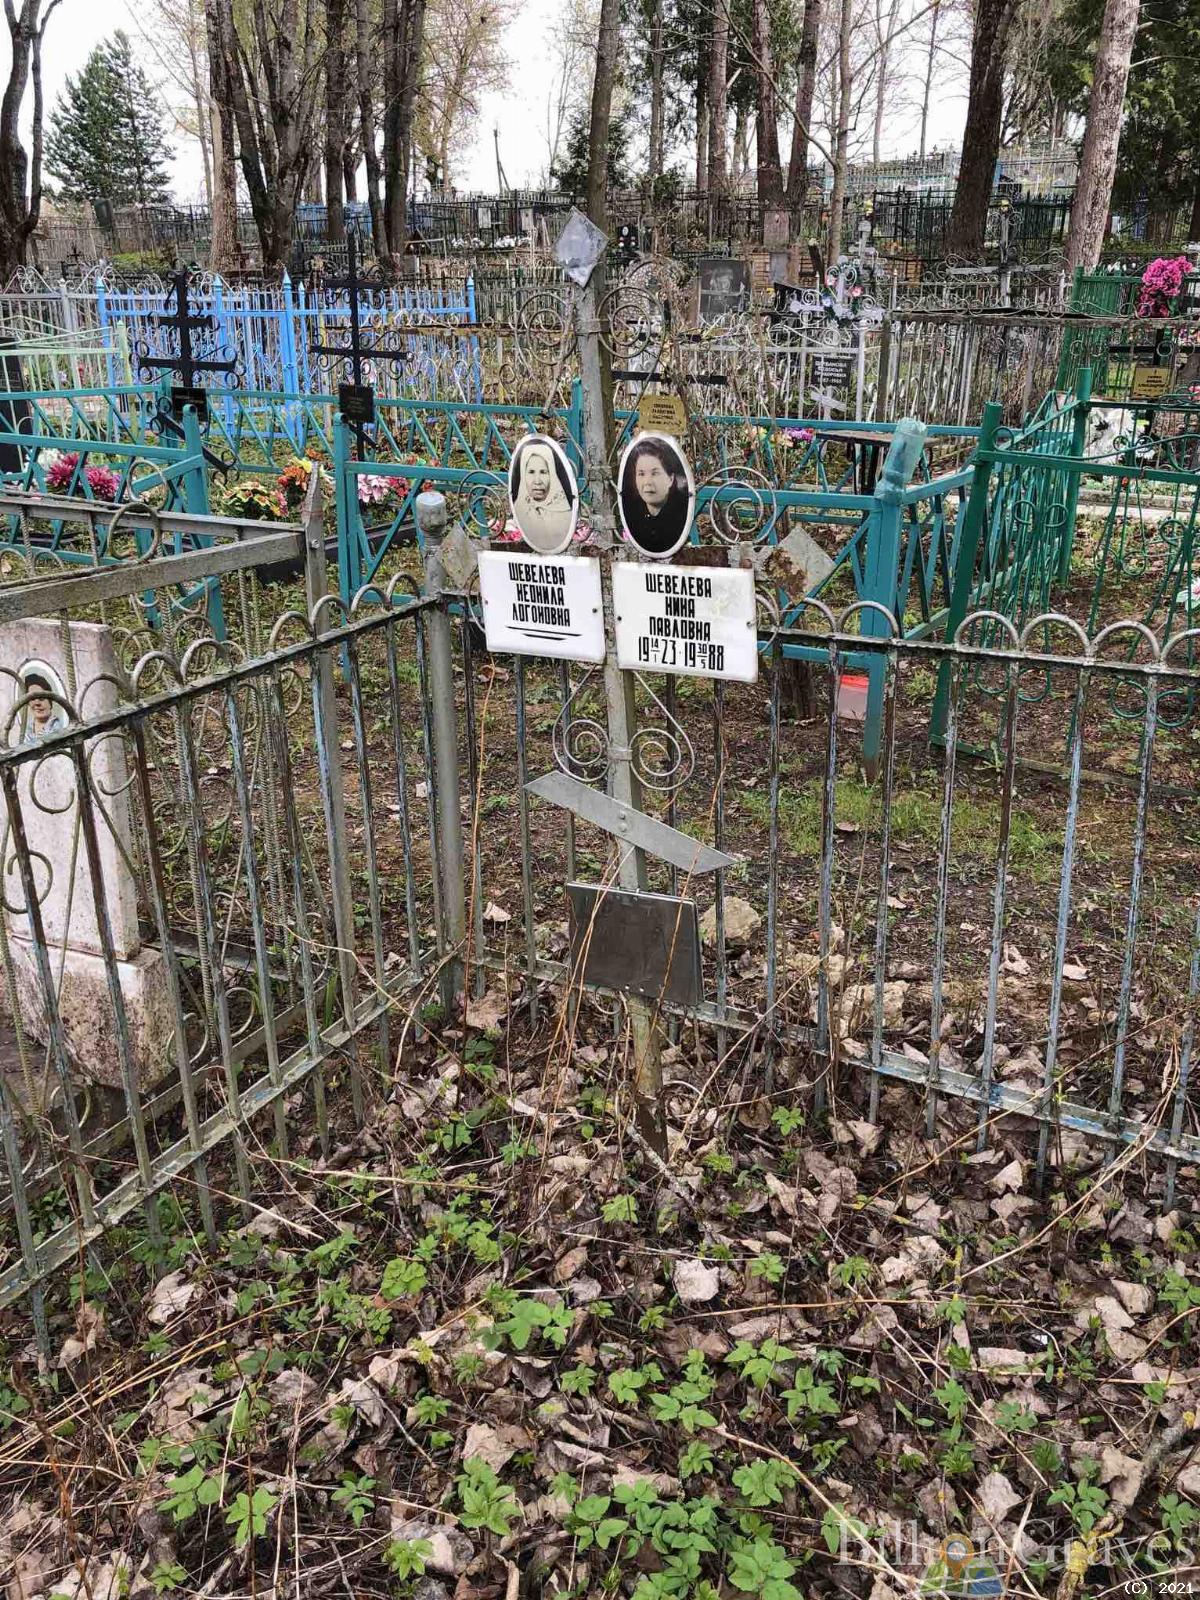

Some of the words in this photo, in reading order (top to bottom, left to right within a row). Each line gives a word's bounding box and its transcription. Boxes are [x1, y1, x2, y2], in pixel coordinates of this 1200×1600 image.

[508, 562, 566, 586] ШЕВЕЛЕВА
[645, 573, 712, 598] ШЕВЕЛЕВА
[516, 583, 565, 606] НЕОНИЛА
[512, 603, 571, 627] ЛОГОНОВНА
[665, 596, 695, 618] НИНА
[649, 616, 711, 641] ПАВЛОВНА
